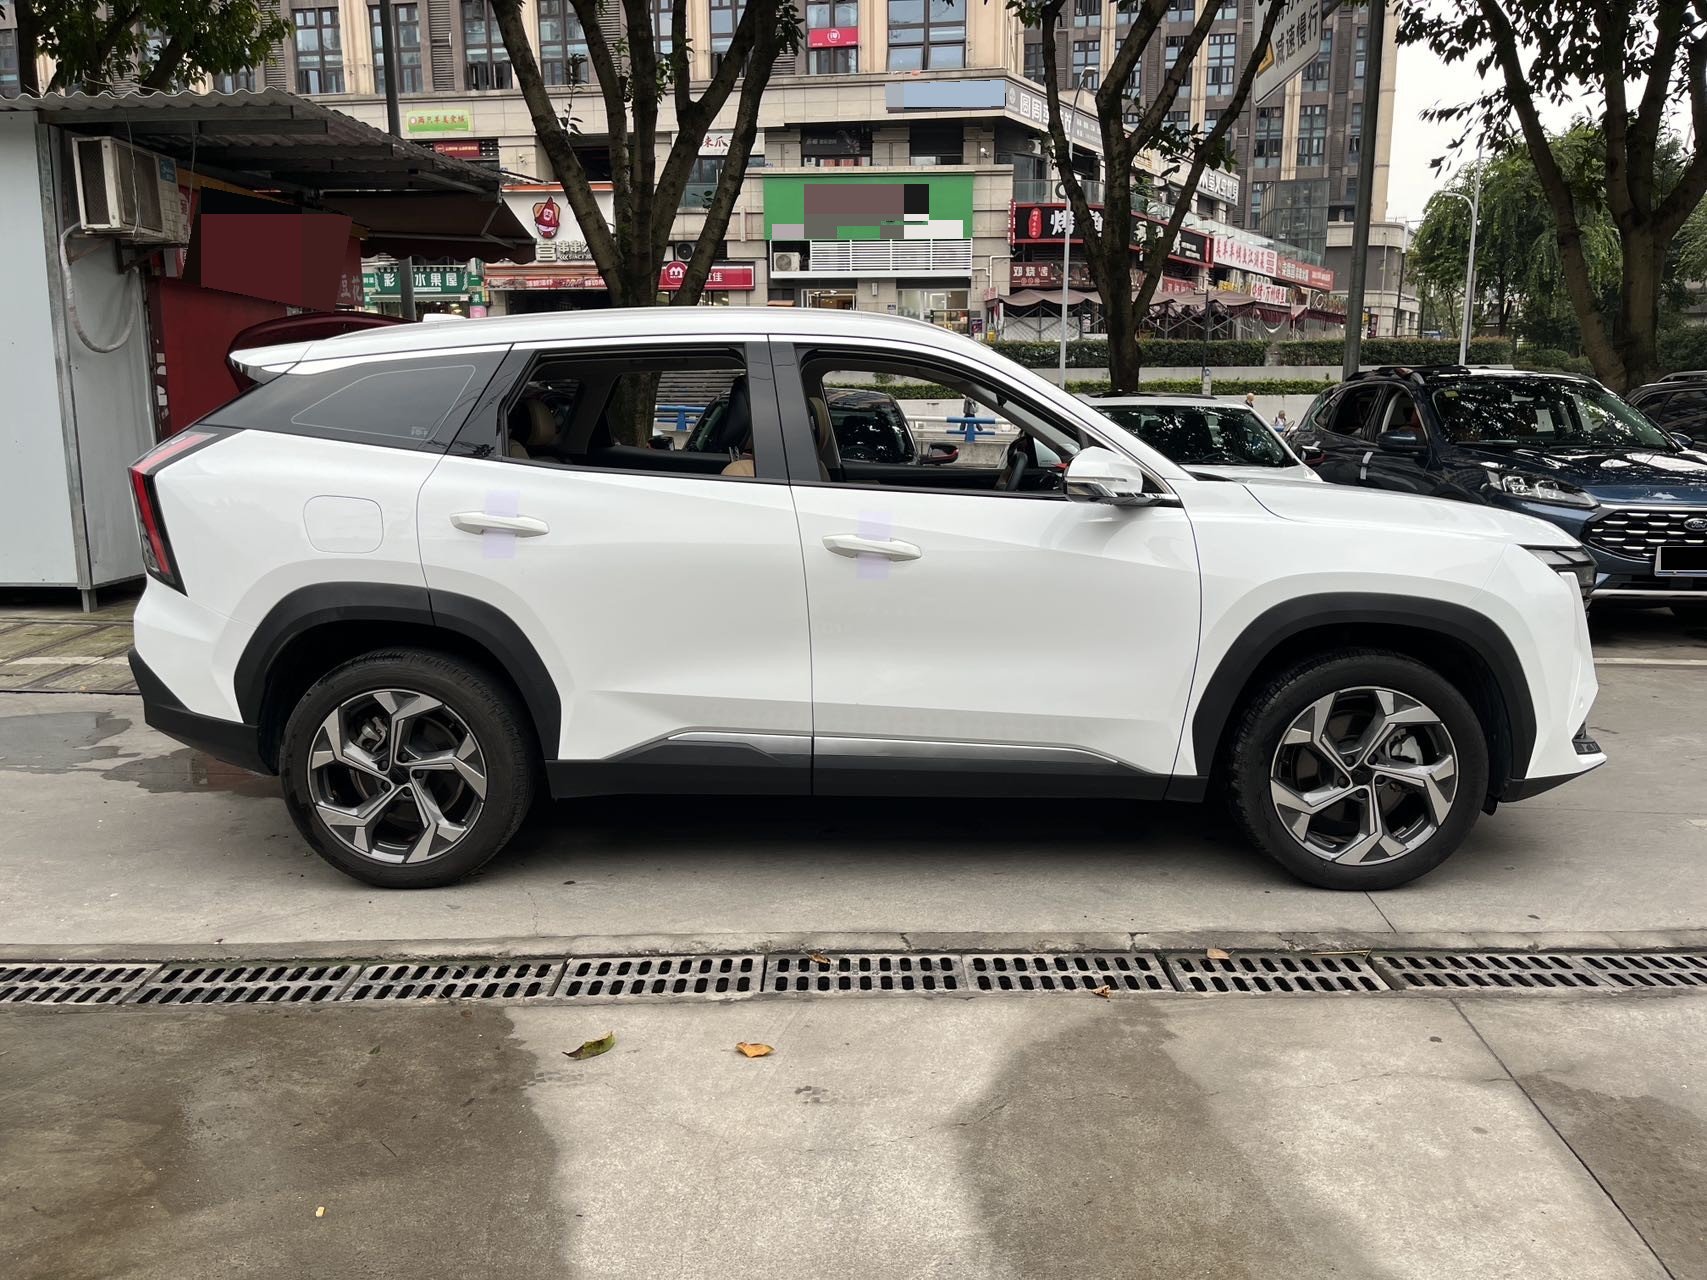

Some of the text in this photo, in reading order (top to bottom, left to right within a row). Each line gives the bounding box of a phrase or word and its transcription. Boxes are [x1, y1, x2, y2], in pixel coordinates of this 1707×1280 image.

[1276, 3, 1319, 69] 减速慢行
[383, 272, 458, 288] 彩水果屋
